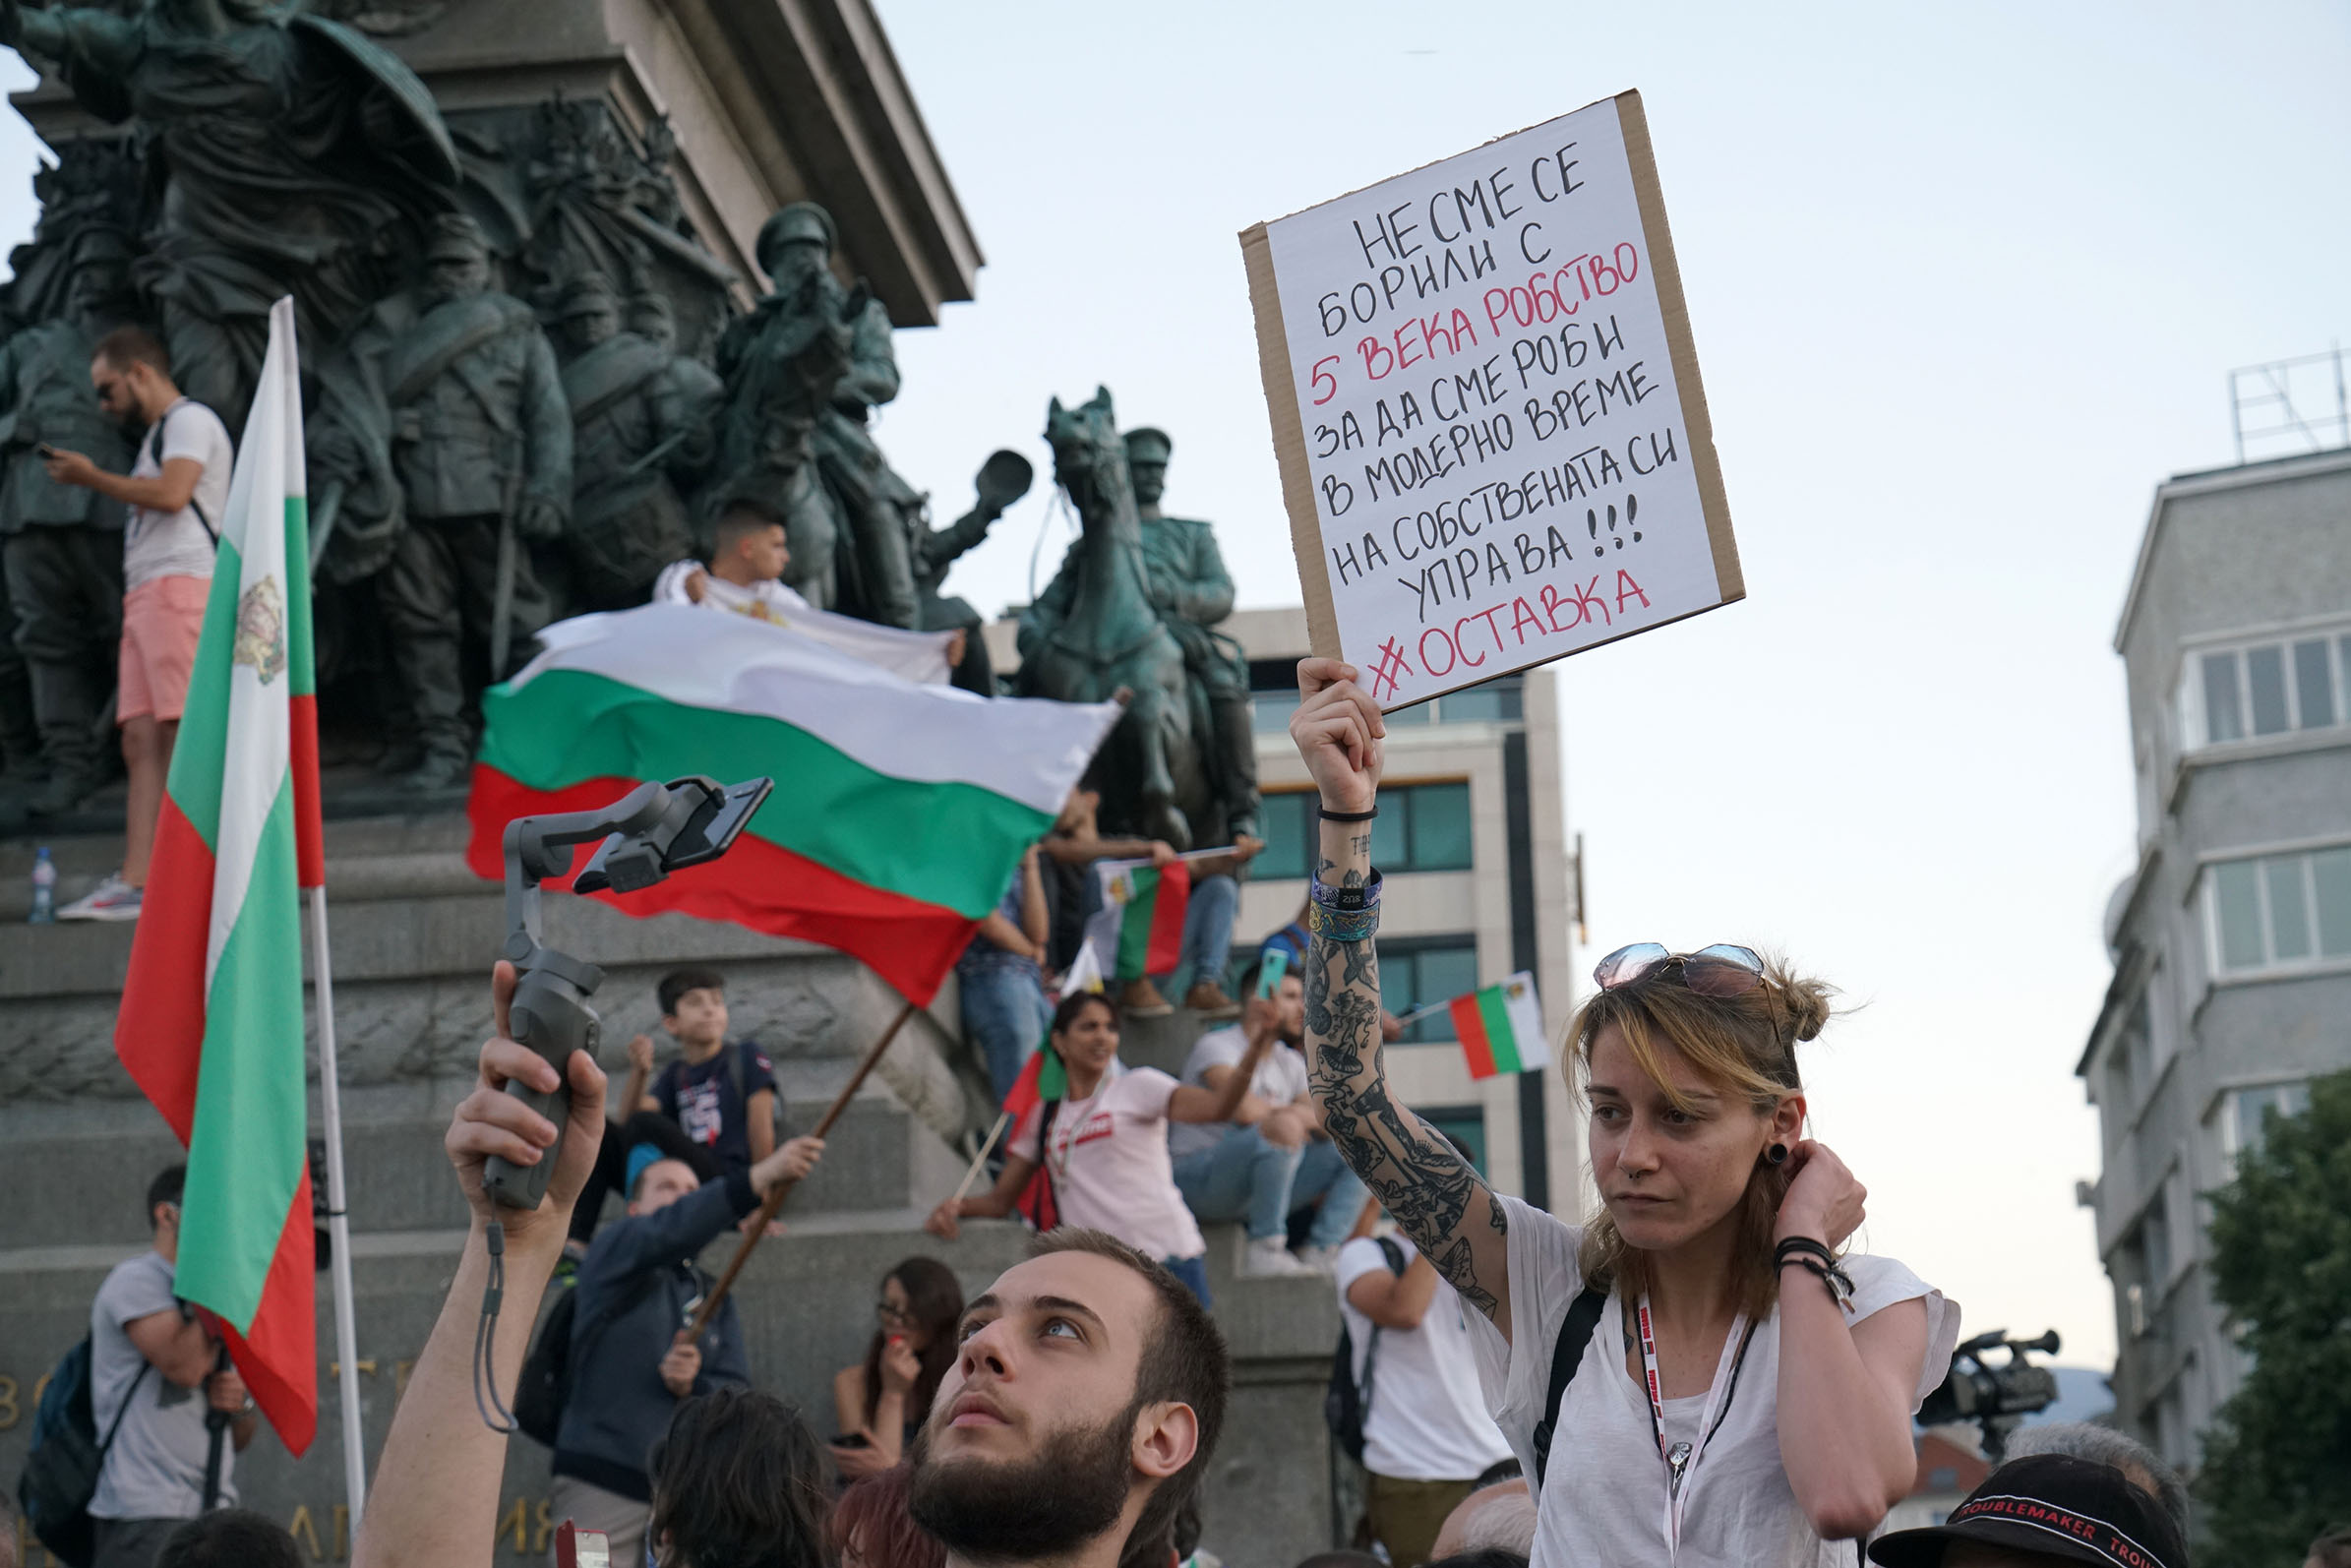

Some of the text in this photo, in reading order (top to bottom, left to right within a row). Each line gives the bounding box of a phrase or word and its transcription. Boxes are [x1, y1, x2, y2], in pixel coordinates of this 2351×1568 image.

[1353, 141, 1585, 270] НЕ СМЕ СЕ
[1311, 242, 1638, 406] 5 ВЕКА РОБСТВО
[1317, 221, 1551, 338] БОРИЛИ С
[1313, 314, 1626, 459] ЗА ДА СМЕ РОБИ
[1321, 360, 1659, 517] В МОДЕРНО ВРЕМЕ
[1331, 427, 1678, 586] НА СОБСТВЕНАТА СИ
[1397, 524, 1574, 625] УПРАВА
[2110, 1537, 2155, 1568] TROU
